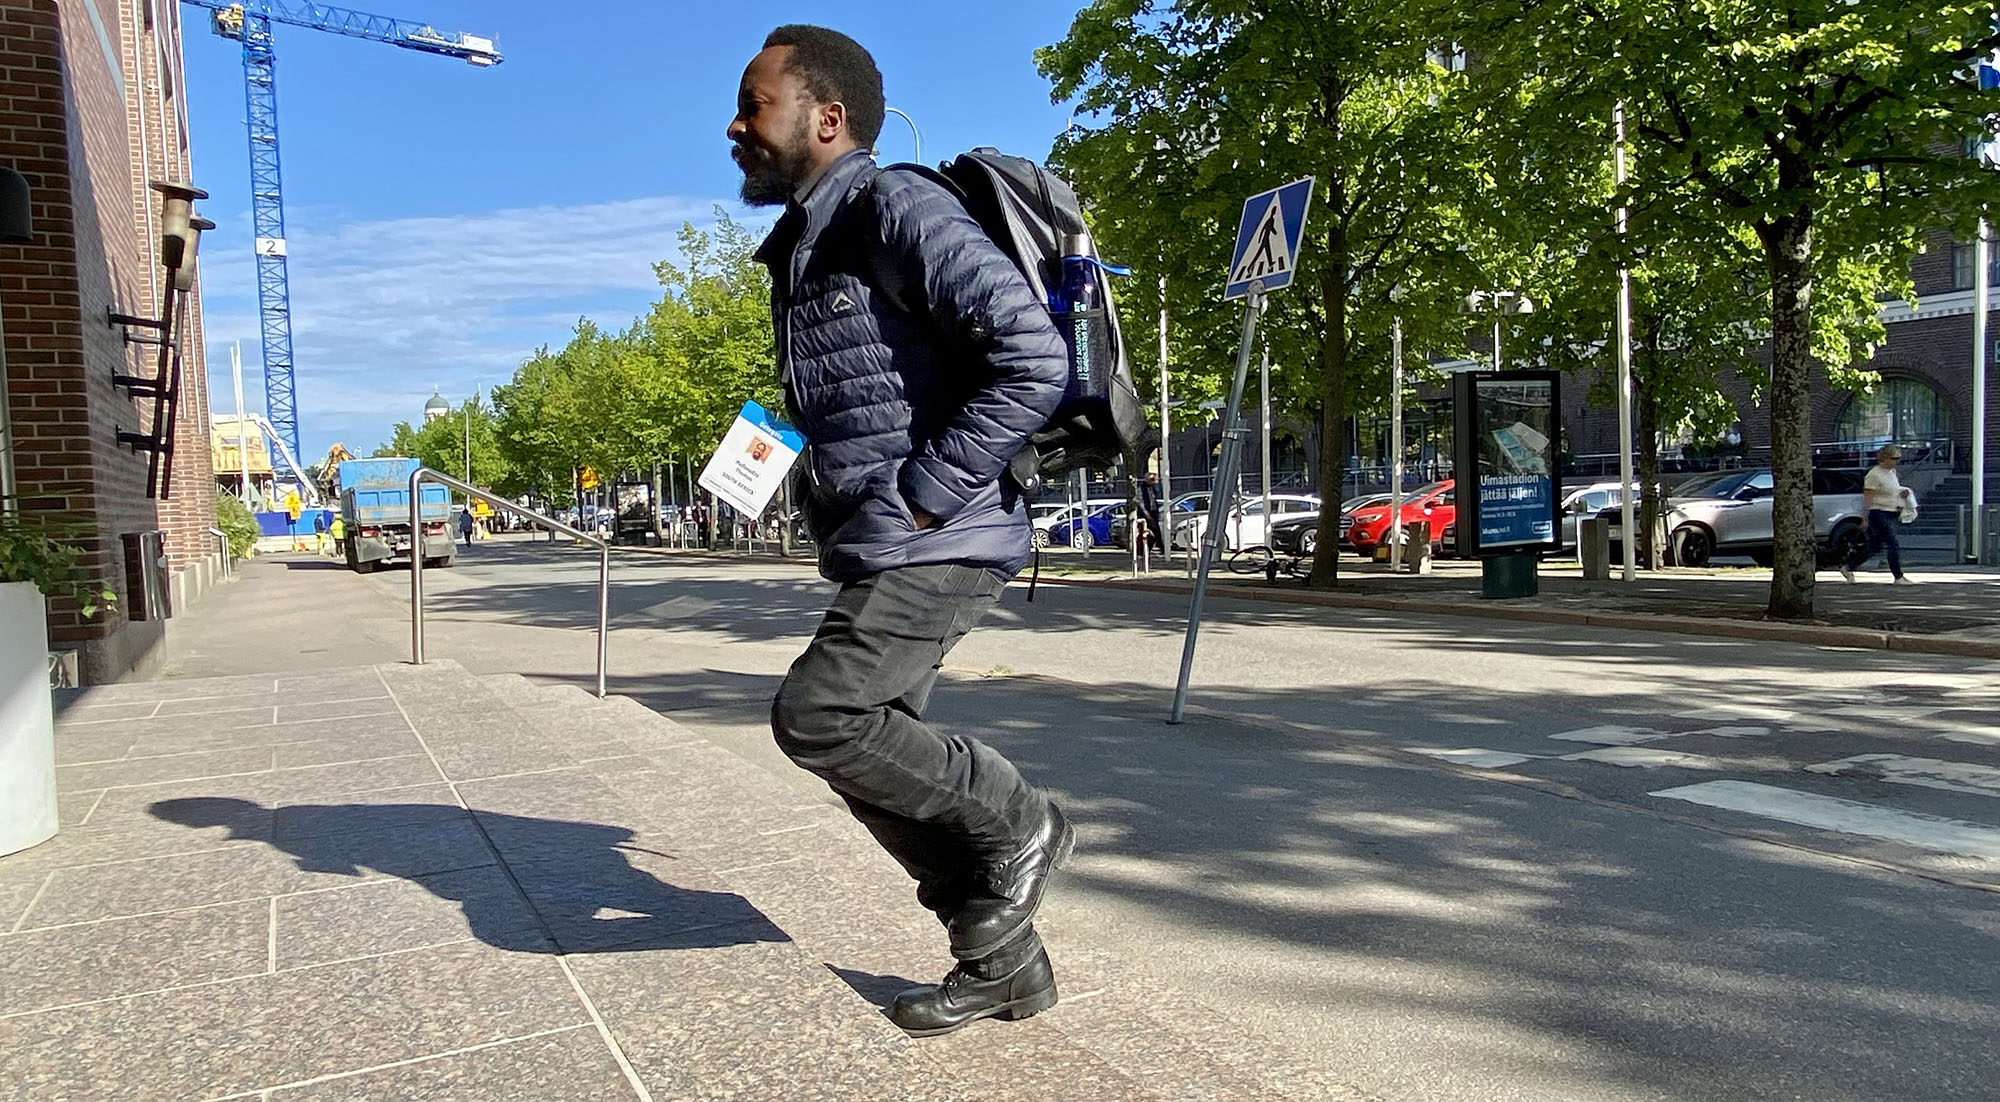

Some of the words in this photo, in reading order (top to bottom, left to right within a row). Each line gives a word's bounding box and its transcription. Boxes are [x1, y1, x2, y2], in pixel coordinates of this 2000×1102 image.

[266, 240, 276, 253] 2
[759, 421, 783, 440] Delegate
[722, 471, 738, 485] SOUTH
[737, 481, 755, 496] AFRICA
[1480, 473, 1539, 486] Uimastadion
[1480, 487, 1507, 503] jättää
[1508, 486, 1538, 502] jäljen!
